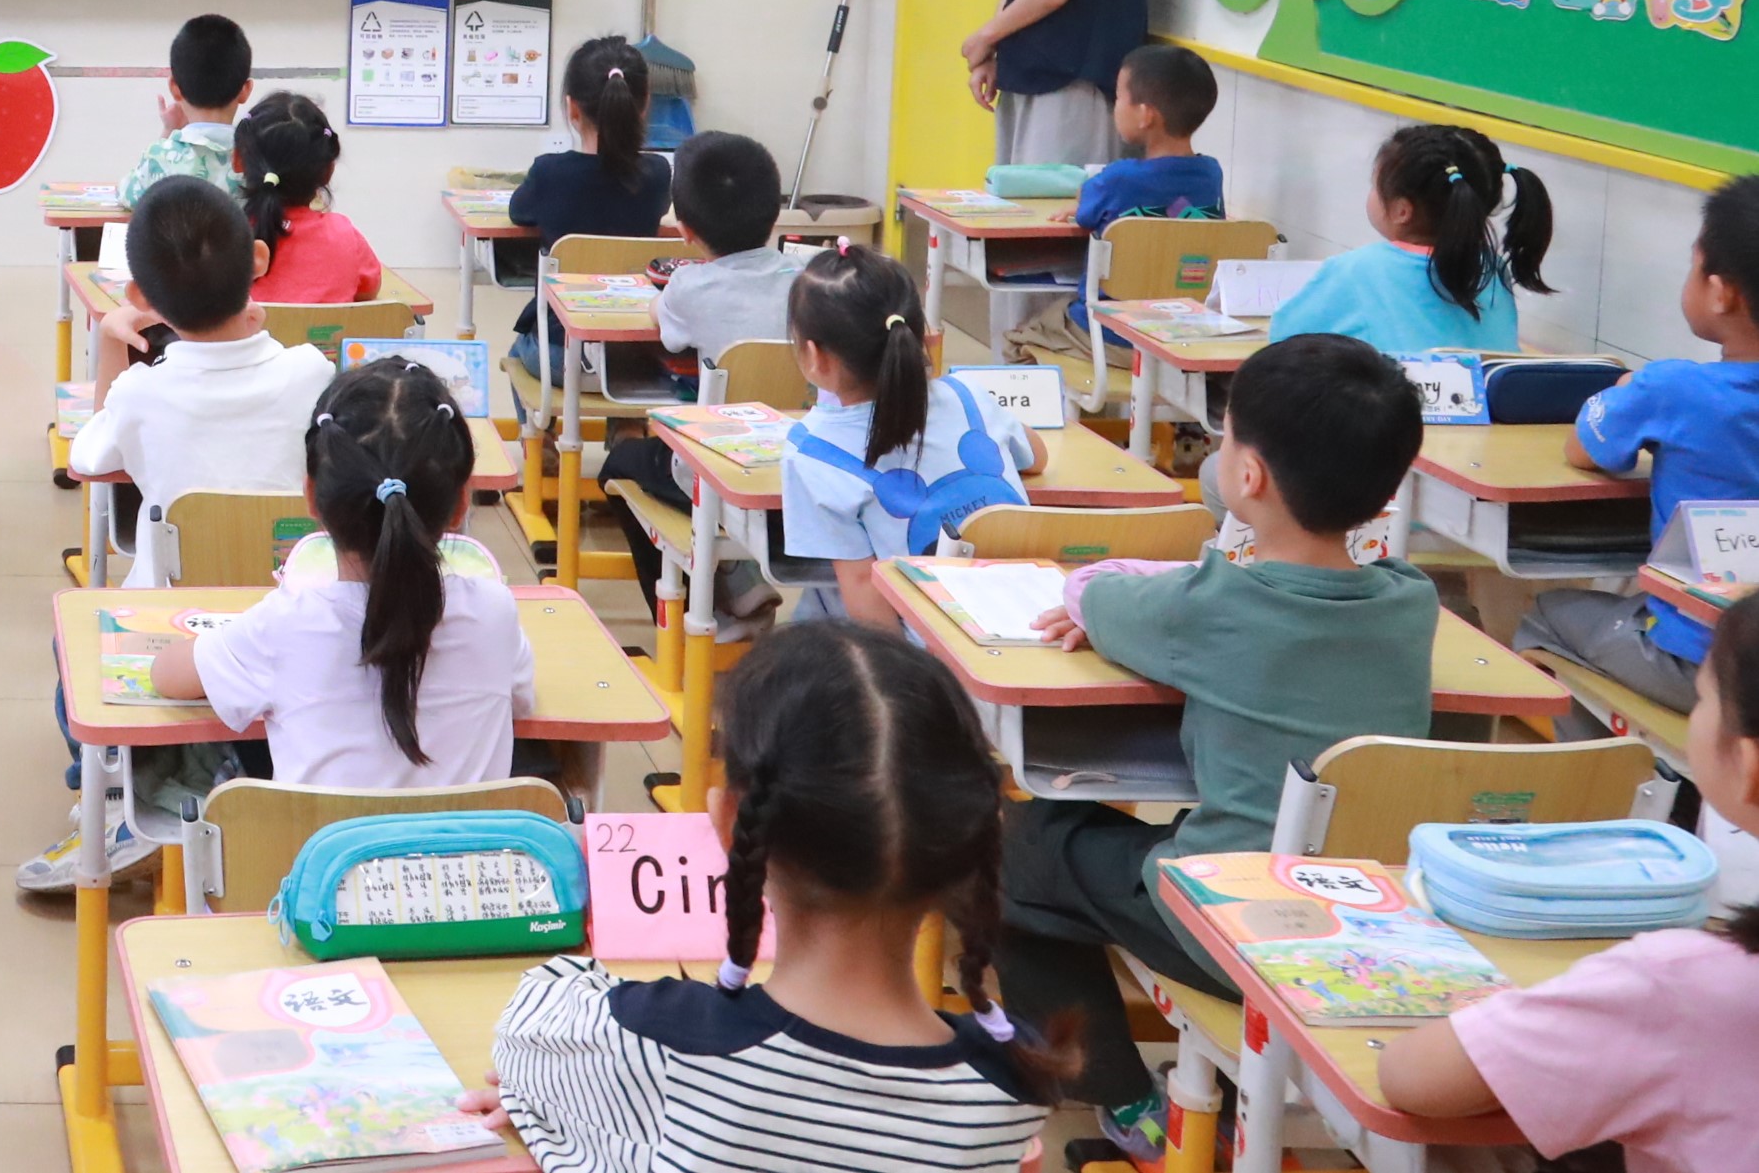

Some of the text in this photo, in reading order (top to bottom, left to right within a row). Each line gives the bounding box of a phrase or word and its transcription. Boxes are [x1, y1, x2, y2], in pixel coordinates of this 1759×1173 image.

[989, 391, 1031, 407] ara
[940, 496, 988, 524] MICKEY
[1715, 528, 1759, 552] Evie
[597, 823, 637, 853] 22
[1296, 871, 1379, 894] 语文
[283, 989, 368, 1013] 语文
